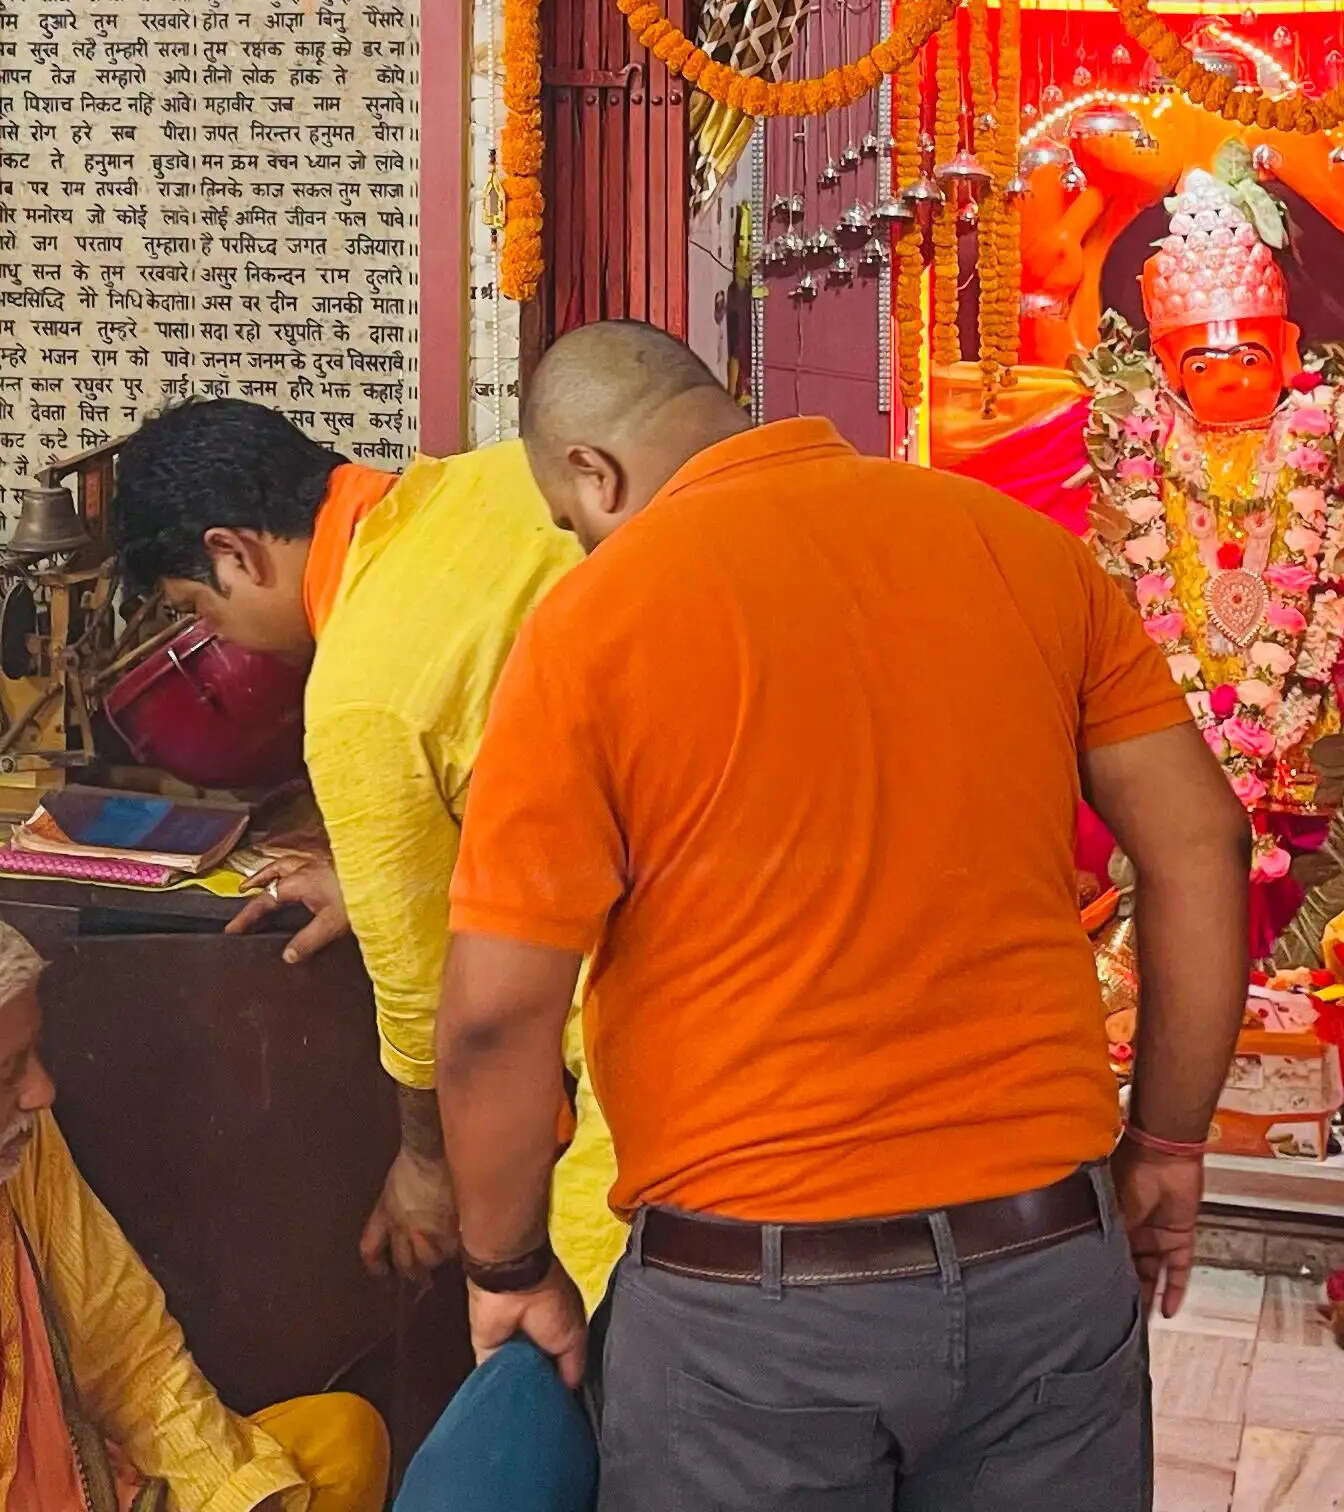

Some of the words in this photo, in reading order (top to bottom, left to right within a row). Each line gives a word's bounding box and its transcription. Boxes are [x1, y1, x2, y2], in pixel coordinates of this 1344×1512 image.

[29, 120, 56, 141] रोग
[70, 120, 92, 144] हरे
[110, 126, 137, 141] सब
[202, 126, 238, 142] जपत
[306, 126, 354, 147] हनुमत
[30, 320, 82, 336] रसायन
[96, 317, 137, 344] तुम्हरे
[199, 323, 227, 341] सदा
[233, 319, 261, 343] रहो
[268, 318, 324, 346] रघुपति
[332, 320, 349, 341] के
